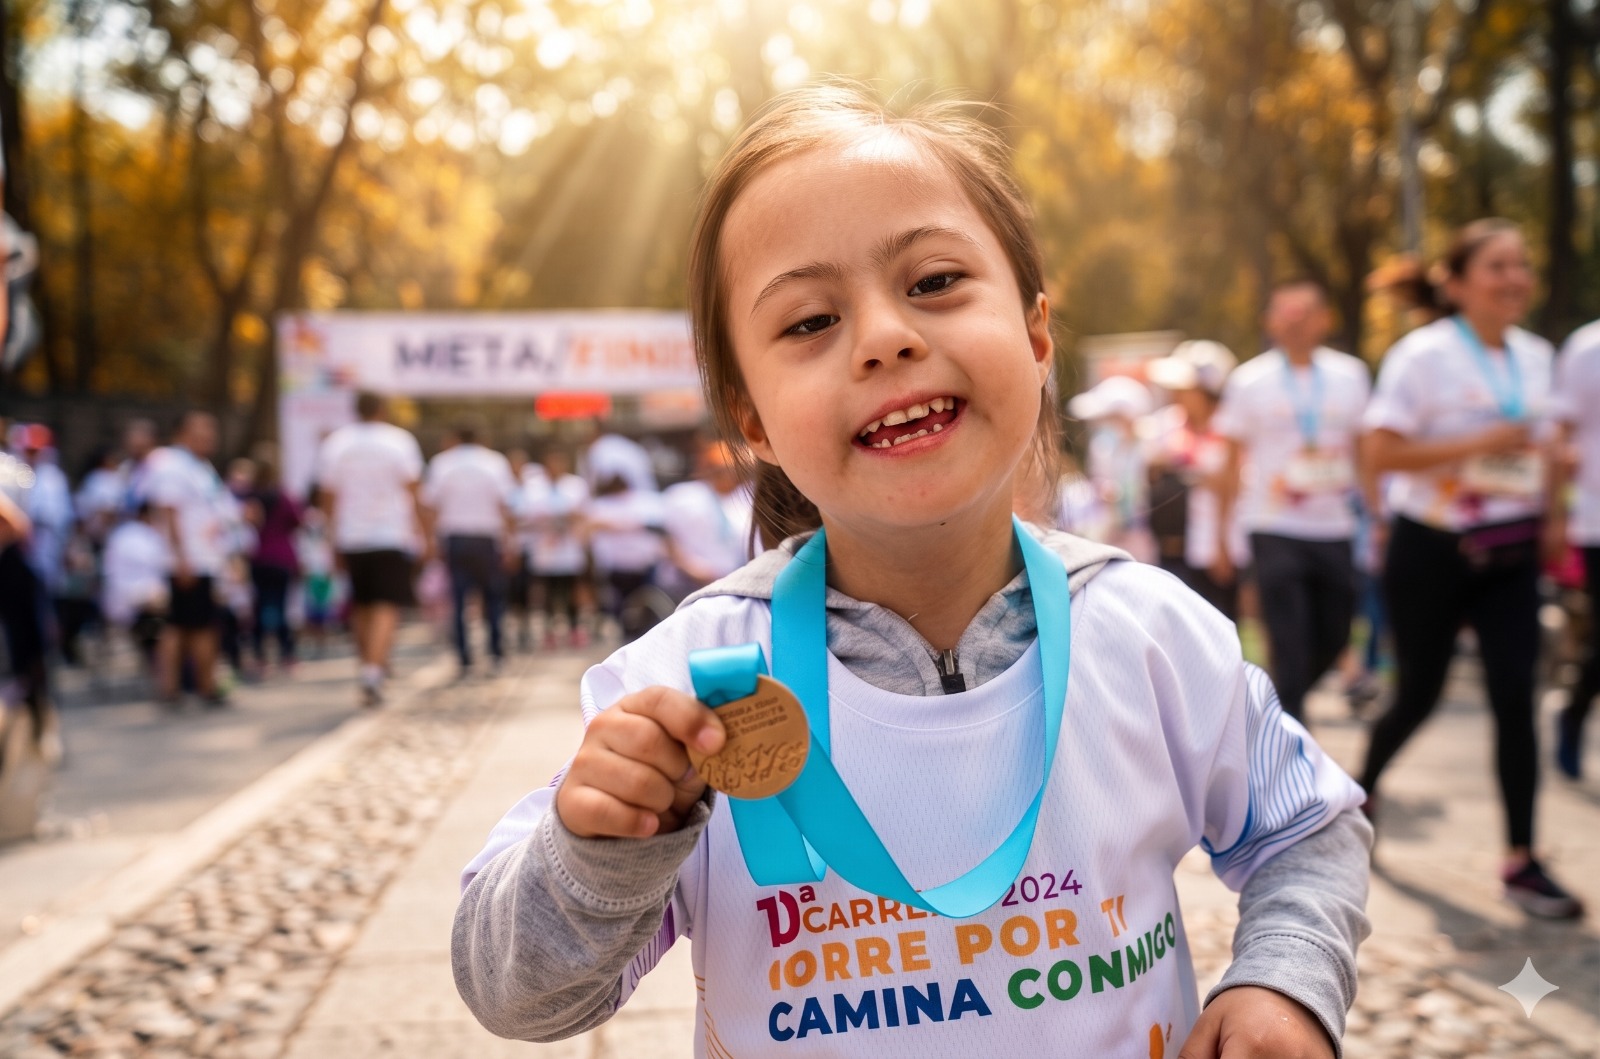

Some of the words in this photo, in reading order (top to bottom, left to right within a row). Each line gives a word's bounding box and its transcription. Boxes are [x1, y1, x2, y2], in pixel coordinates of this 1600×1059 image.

[1001, 869, 1083, 907] 2024
[955, 908, 1081, 965] POR
[768, 978, 992, 1042] CAMINA
[1007, 911, 1176, 1010] CONMIGO
